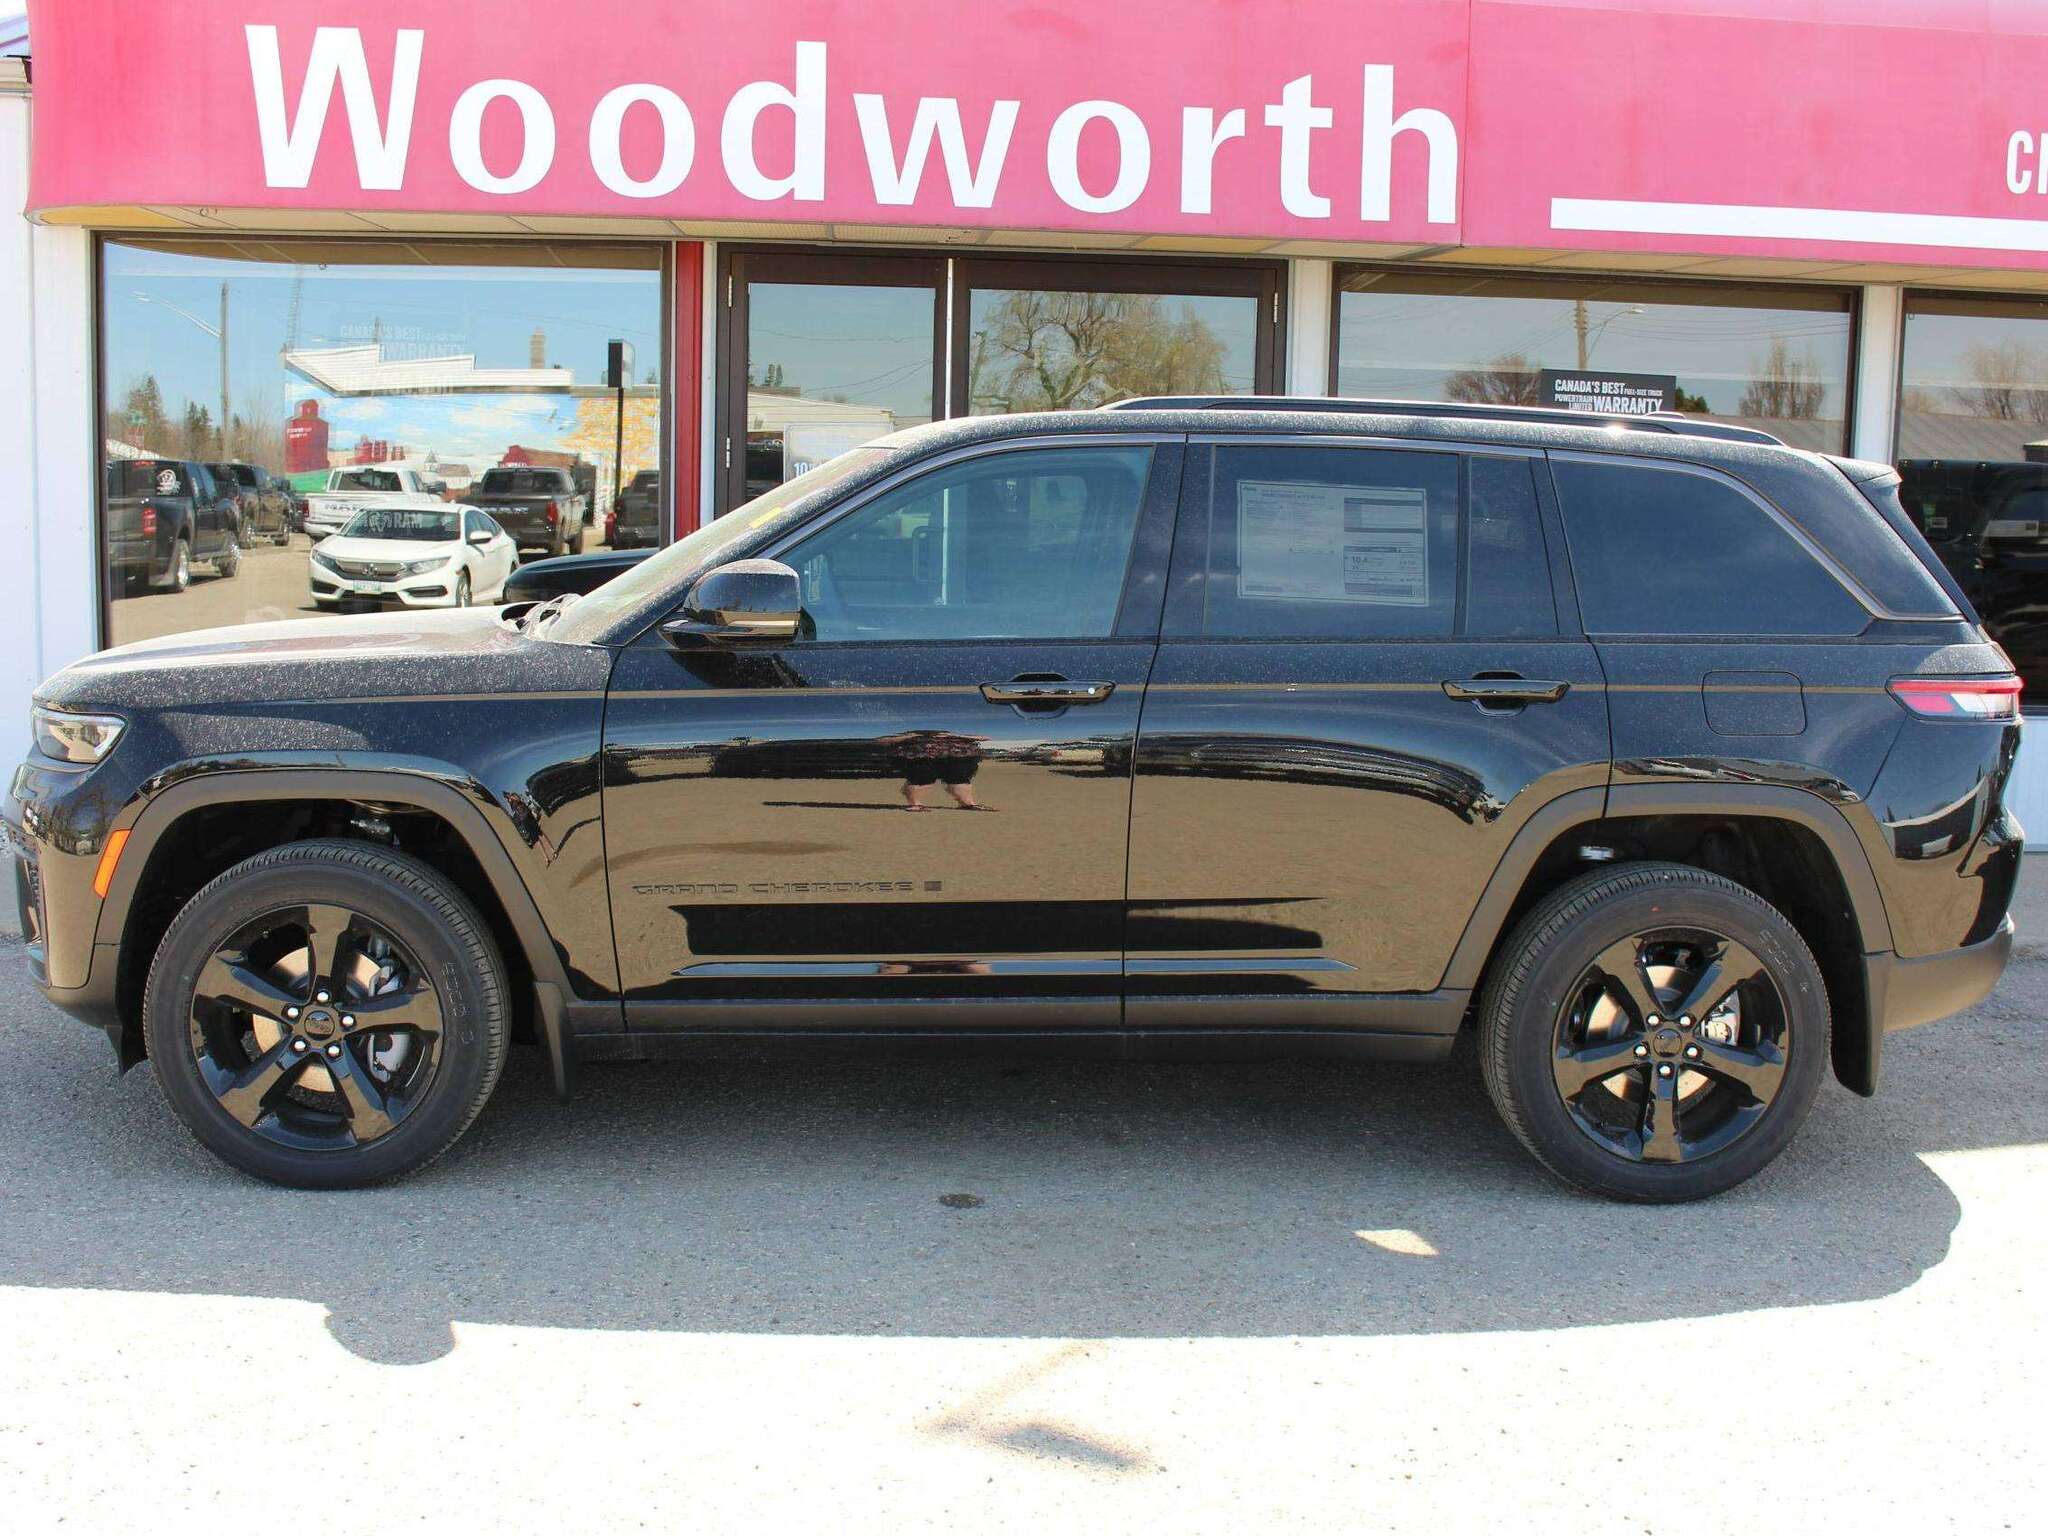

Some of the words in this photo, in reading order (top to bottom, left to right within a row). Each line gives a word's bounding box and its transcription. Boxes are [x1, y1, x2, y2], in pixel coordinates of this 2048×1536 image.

[245, 24, 1458, 224] Woodworth
[1555, 379, 1600, 393] CANADA'S
[1602, 381, 1625, 395] BEST
[1554, 393, 1594, 403] POWERTRAIN
[1594, 396, 1663, 413] WARRANTY
[631, 882, 738, 896] GRAND
[748, 880, 914, 894] CHEROKEE
